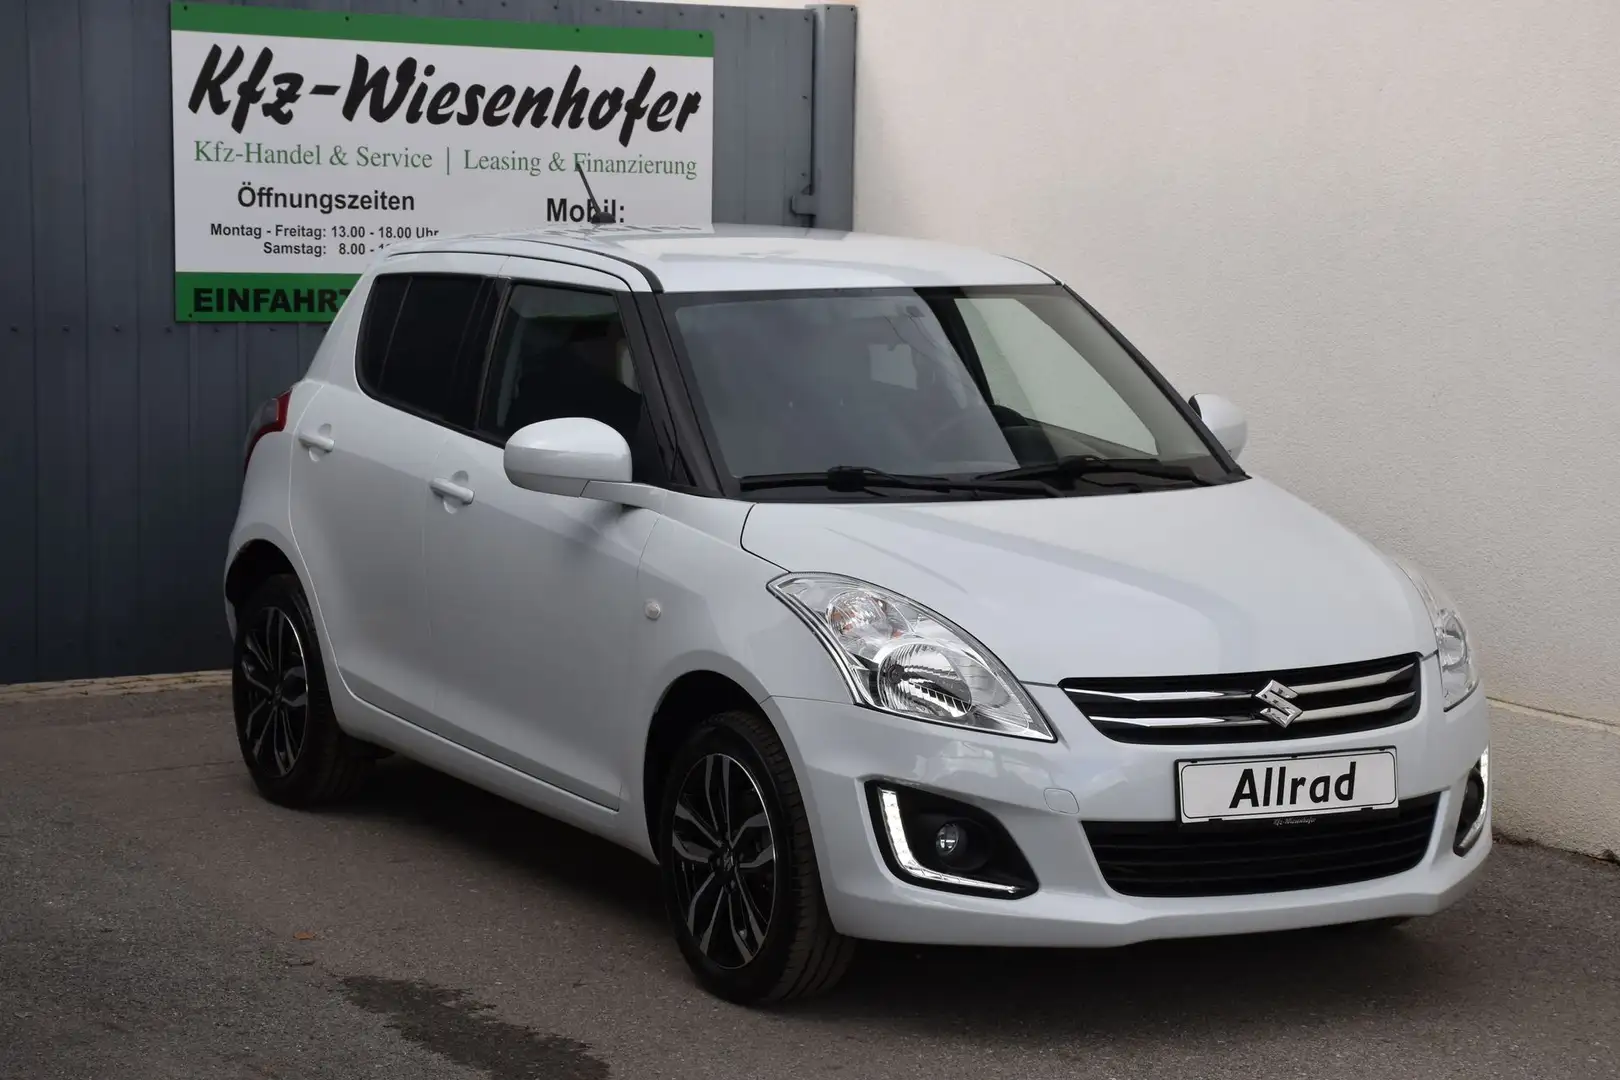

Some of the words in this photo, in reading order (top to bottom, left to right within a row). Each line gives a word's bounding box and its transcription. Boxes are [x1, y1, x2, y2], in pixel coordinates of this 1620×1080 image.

[188, 43, 702, 148] Kfz-Wiesenhofer
[194, 140, 321, 166] Kfz-Handel
[329, 145, 349, 166] &
[356, 145, 433, 169] Service
[464, 149, 542, 177] Leasing
[548, 151, 567, 170] &
[573, 152, 698, 181] Finanzierung
[237, 181, 415, 214] Öffnungszeiten
[210, 223, 262, 240] Montag
[275, 224, 327, 241] Freitag:
[331, 226, 366, 239] 13.00
[378, 226, 412, 239] 18.00
[416, 226, 440, 239] Uhr
[263, 242, 327, 258] Samstag:
[338, 243, 366, 256] 8.00
[1229, 761, 1357, 809] Allrad
